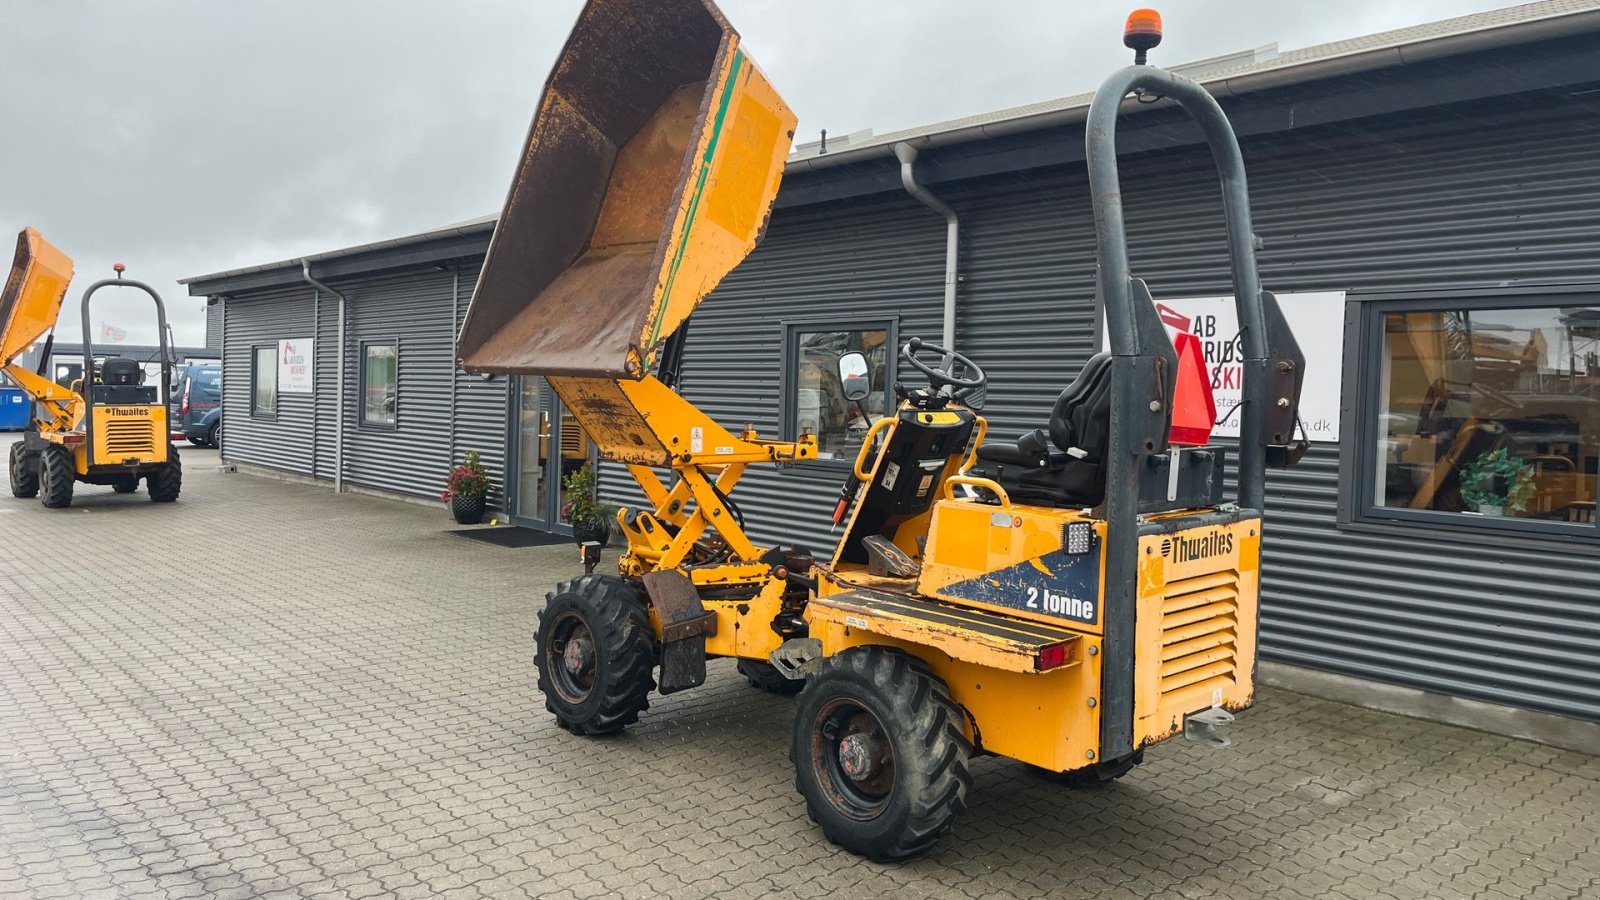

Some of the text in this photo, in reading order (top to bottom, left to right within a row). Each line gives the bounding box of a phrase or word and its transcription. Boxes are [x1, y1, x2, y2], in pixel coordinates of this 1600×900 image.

[1194, 315, 1216, 337] AB
[111, 408, 149, 416] Thwaites
[1172, 530, 1233, 563] Thwaites
[1027, 586, 1093, 619] 2 tonne
